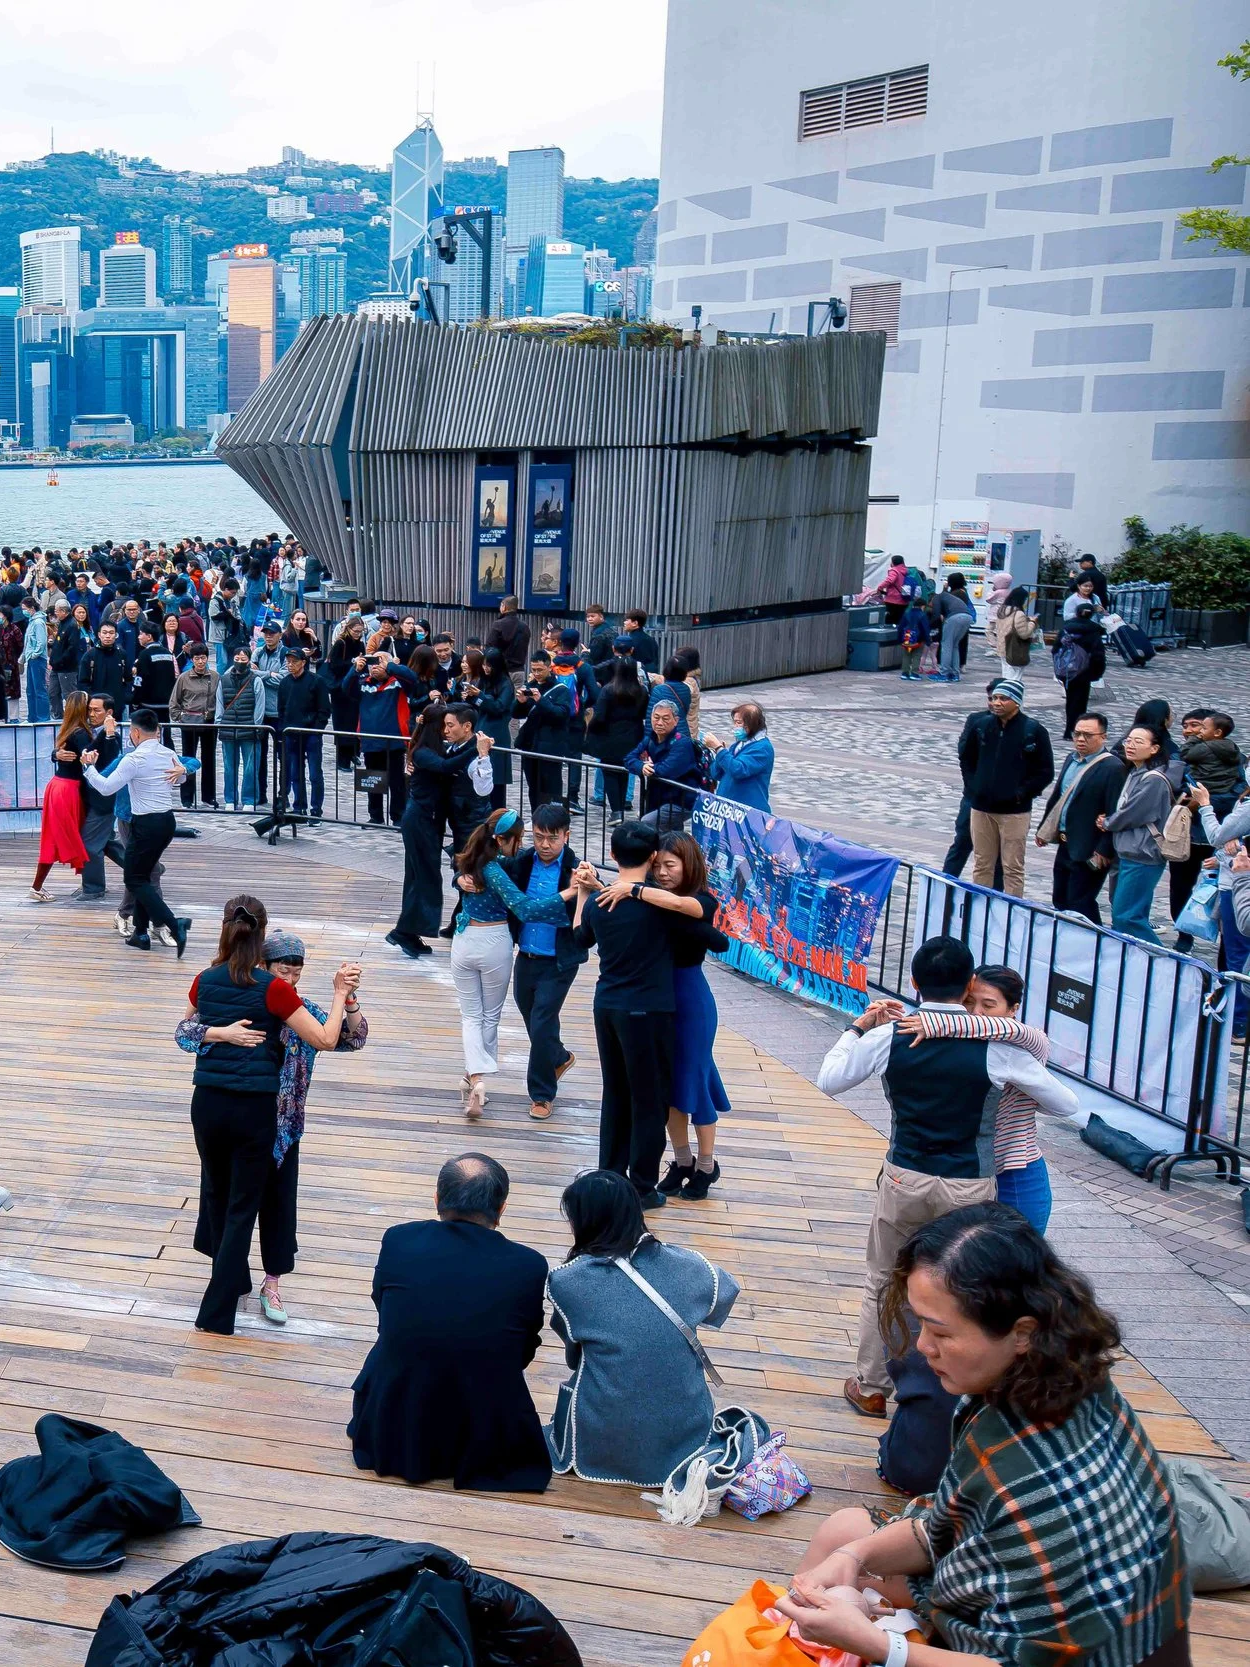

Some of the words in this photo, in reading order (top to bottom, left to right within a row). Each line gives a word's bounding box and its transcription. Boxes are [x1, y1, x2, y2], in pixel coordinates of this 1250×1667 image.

[693, 810, 725, 832] GARDEN
[703, 798, 747, 825] SALISBURY
[791, 937, 807, 969] 25
[811, 944, 844, 984] MAR
[847, 960, 868, 993] 30
